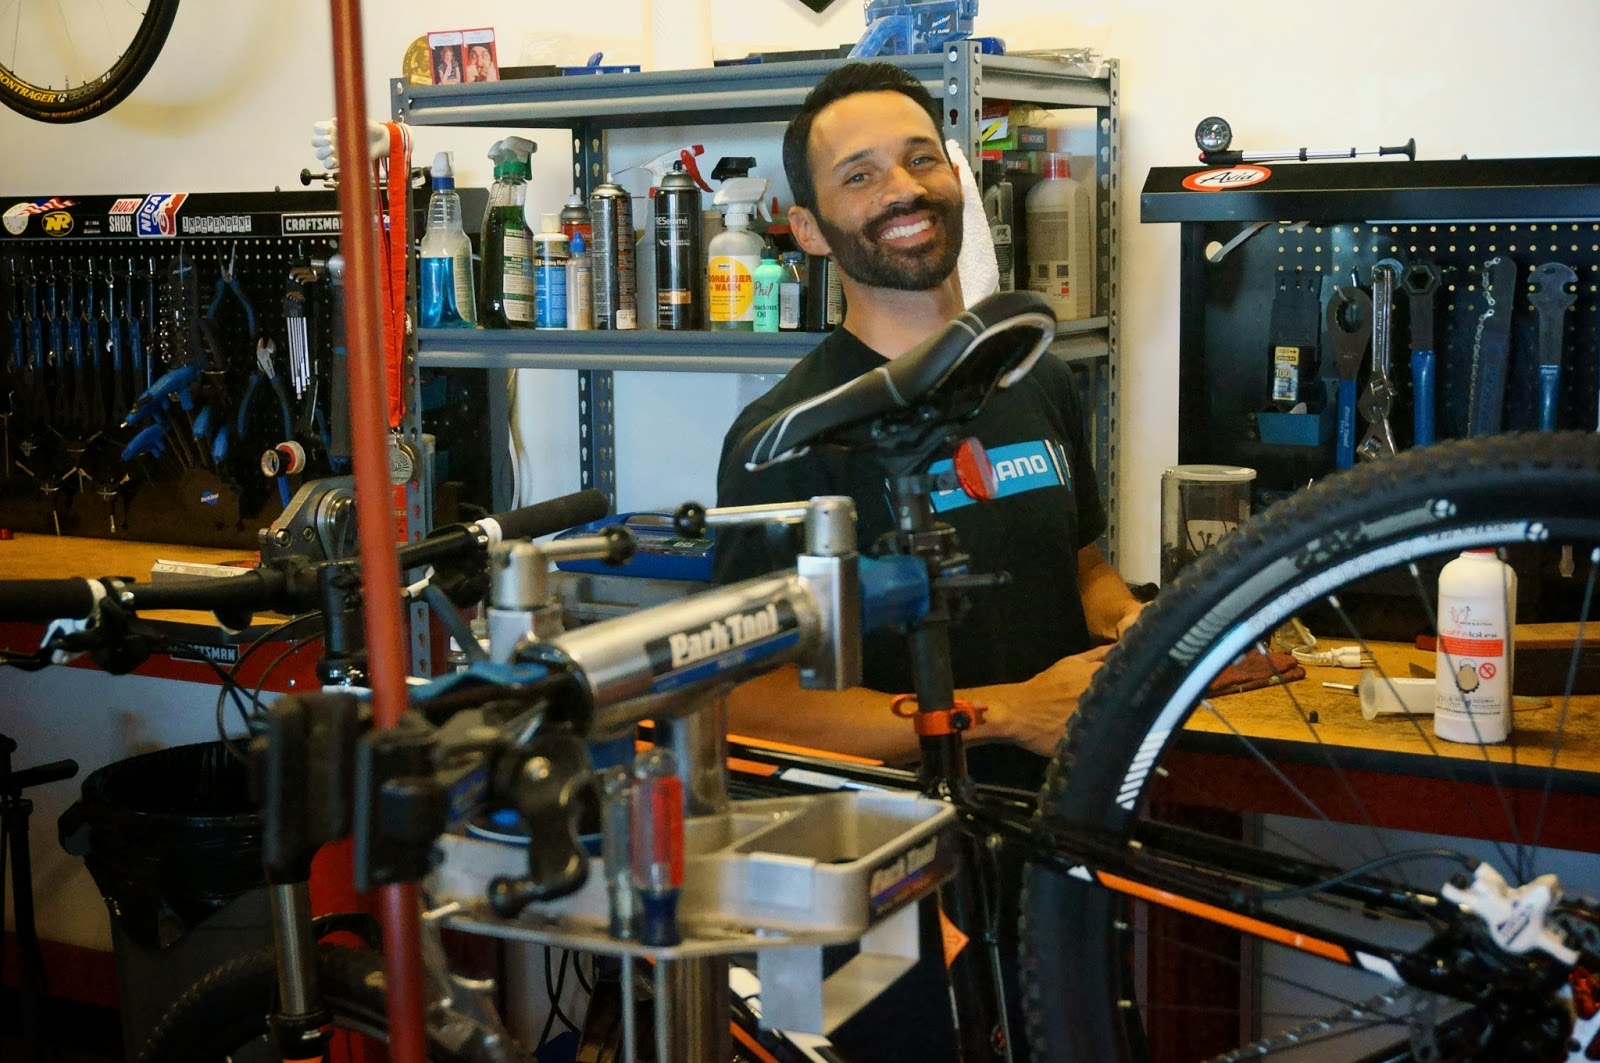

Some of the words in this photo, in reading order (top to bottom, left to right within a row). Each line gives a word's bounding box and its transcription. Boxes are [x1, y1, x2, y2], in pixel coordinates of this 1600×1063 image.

[1200, 171, 1258, 184] Avid
[112, 200, 138, 213] ROCK
[141, 196, 162, 232] NICA
[109, 215, 132, 233] SHOX
[182, 215, 252, 233] INDEPENDENT
[754, 281, 774, 299] Phil
[754, 303, 778, 311] nacious
[668, 621, 729, 668] Park
[724, 603, 779, 646] Tool
